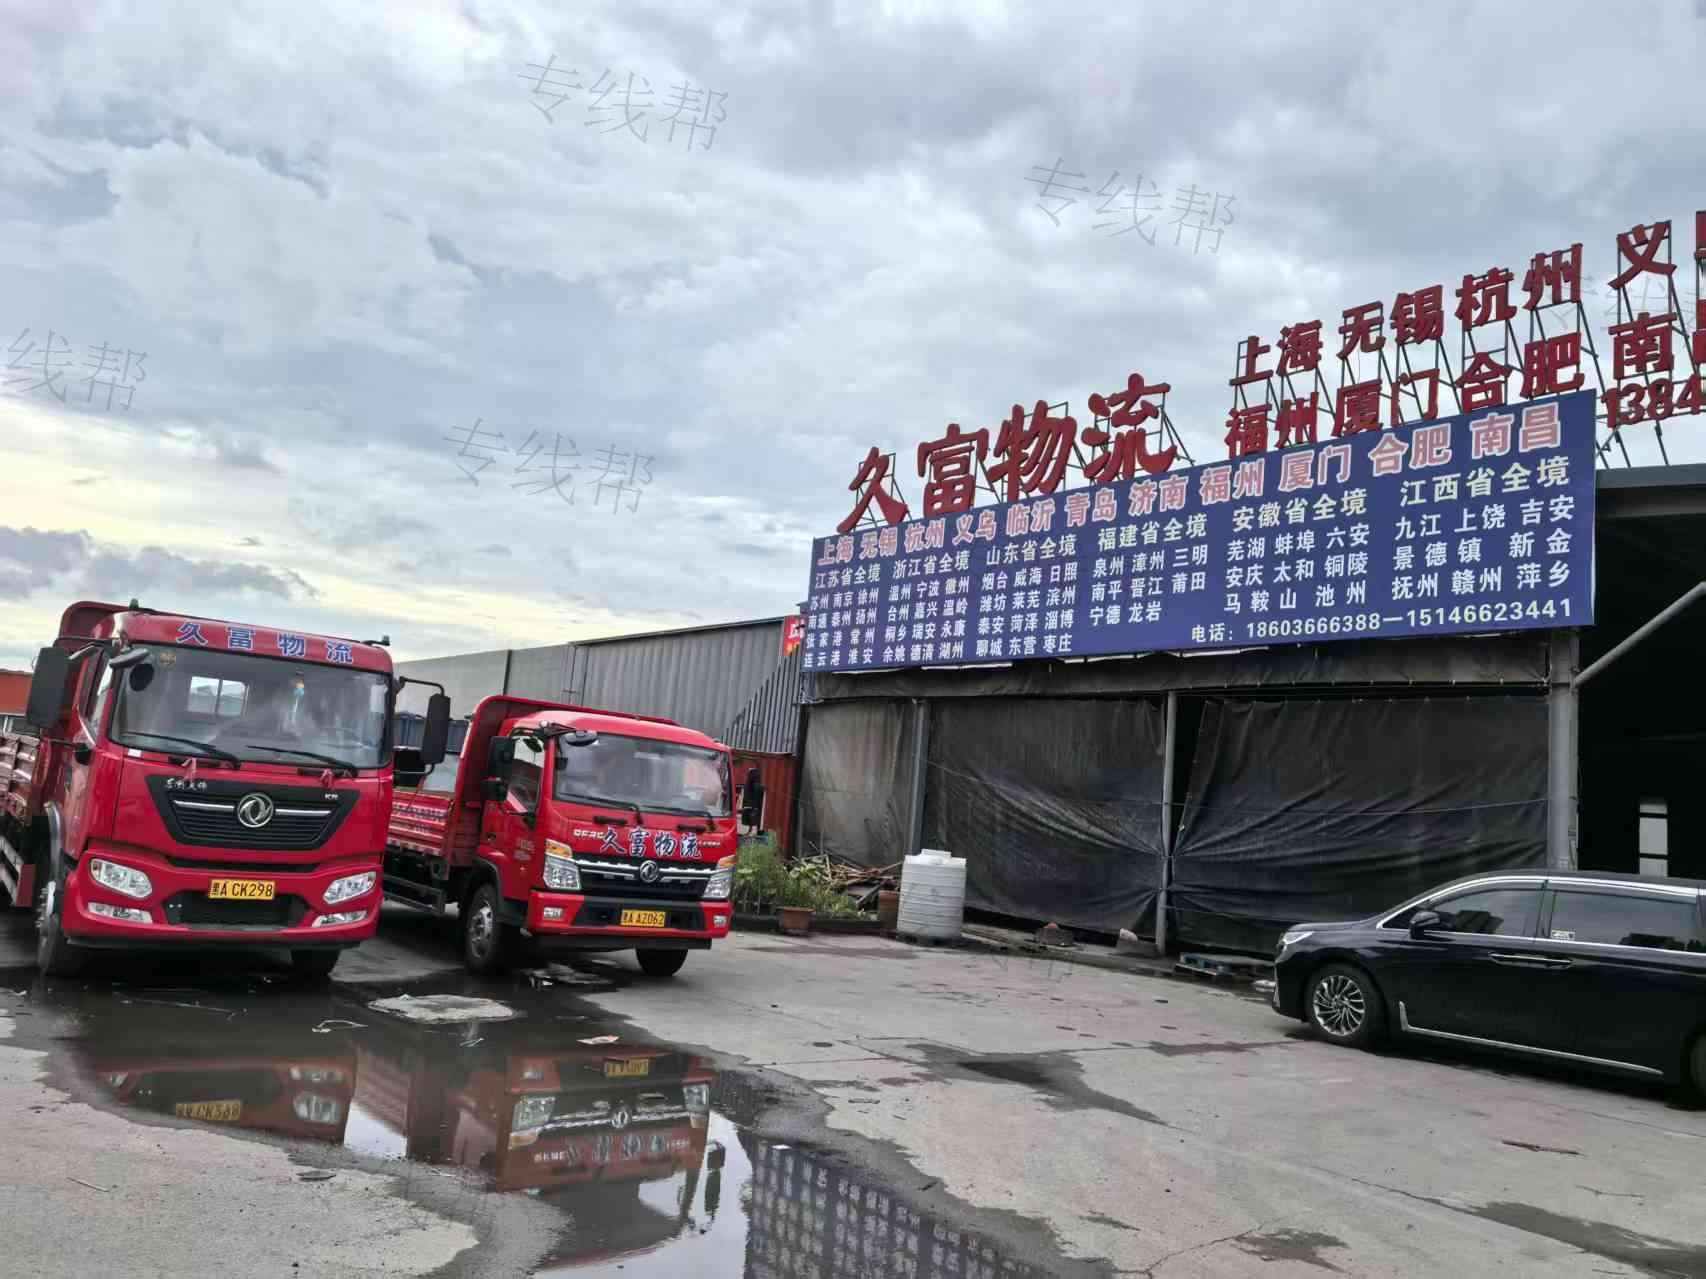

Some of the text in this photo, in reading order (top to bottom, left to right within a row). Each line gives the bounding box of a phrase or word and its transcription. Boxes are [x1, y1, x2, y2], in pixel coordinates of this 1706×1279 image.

[1229, 319, 1323, 386] 上海
[1337, 284, 1444, 359] 无锡
[1455, 243, 1583, 330] 杭州
[1607, 211, 1706, 290] 义
[1225, 392, 1318, 459] 福州
[1331, 367, 1441, 437] 厦门
[1455, 332, 1586, 414] 合肥
[1607, 299, 1706, 379] 南
[837, 373, 1178, 534] 久富物流
[816, 402, 1561, 565] 上海 无锡 杭州 义乌 临沂 青岛 济南 福州 厦门 合肥 南昌
[815, 455, 1569, 589] 江苏省全境 浙江省全境 山东省全境 福建省全境 安徽省全境 江西省全境
[1395, 495, 1575, 541] 九江 上饶 吉安
[1227, 522, 1370, 562] 芜湖 蚌埠 六安
[1393, 537, 1482, 571] 景德镇
[981, 562, 1078, 591] 烟台 威海 日照
[1093, 544, 1208, 578] 泉州 漳州 三明
[1226, 552, 1369, 589] 安庆 太和 铜陵
[889, 583, 911, 601] 温州
[917, 579, 940, 599] 宁波
[1091, 571, 1206, 602] 南平 晋江 莆田
[1224, 579, 1366, 614] 马鞍山 池州
[1391, 560, 1571, 601] 抚州 赣州 萍乡
[810, 587, 879, 611] 苏州 南京 徐州
[888, 598, 968, 622] 台州 嘉兴 温岭
[980, 585, 1076, 612] 潍坊 莱芜 滨州
[1089, 601, 1162, 626] 宁德 龙岩
[850, 627, 875, 645] 常州
[885, 620, 966, 642] 桐乡 瑞安 永康
[978, 609, 1075, 635] 泰安 菏泽 淄博
[176, 621, 354, 664] 久富物流
[804, 648, 873, 668] 连云港 淮安
[882, 641, 963, 663] 余姚 德清 湖州
[976, 633, 1072, 657] 聊城 东营 枣庄
[601, 825, 702, 858] 久富物流
